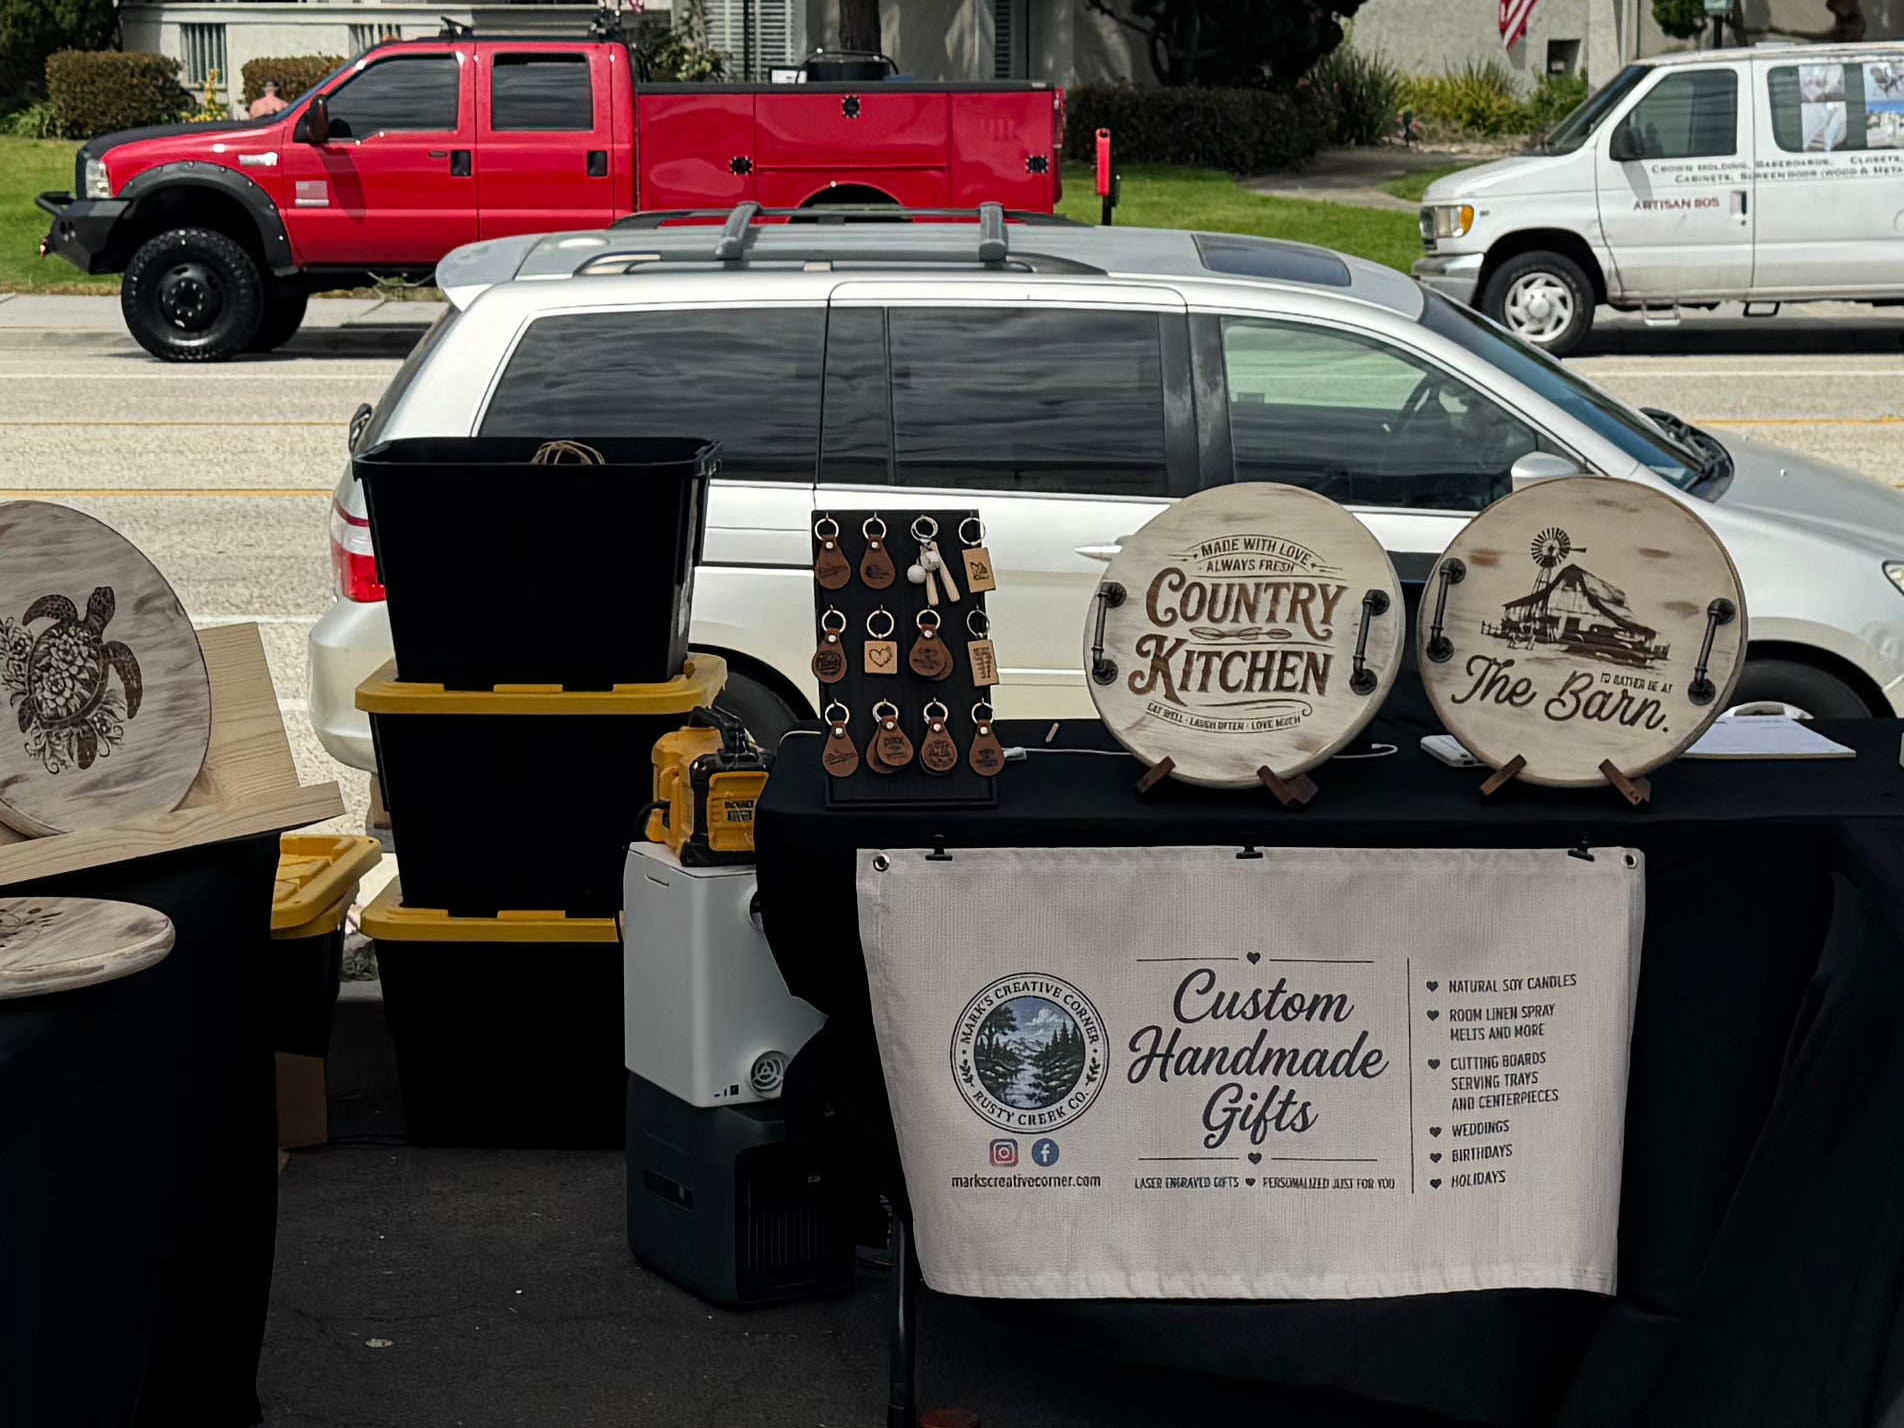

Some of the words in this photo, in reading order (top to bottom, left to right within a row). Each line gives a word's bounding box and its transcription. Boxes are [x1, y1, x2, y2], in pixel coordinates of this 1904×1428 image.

[1633, 199, 1691, 211] ARTISAN
[1201, 538, 1240, 558] MADE
[1244, 538, 1276, 552] WITH
[1279, 542, 1312, 566] LOVE
[1206, 559, 1255, 572] ALWAYS
[1259, 559, 1295, 573] FRESH
[1146, 567, 1349, 641] COUNTRY
[1127, 634, 1335, 707] KITCHEN
[1451, 655, 1537, 707] The
[1544, 670, 1669, 732] Barn.
[1449, 979, 1497, 993] NATURAL
[1503, 978, 1524, 992] SOY
[1528, 974, 1577, 990] CANDLES
[1173, 968, 1354, 1024] Custom
[960, 995, 994, 1044] MARK'S
[994, 981, 1062, 1000] CREATIVE
[1064, 994, 1100, 1045] CORNER
[1450, 1008, 1482, 1022] ROOM
[1486, 1006, 1518, 1020] LINEN
[1522, 1004, 1556, 1018] SPRAY
[1450, 1028, 1485, 1042] MELTS
[1489, 1026, 1511, 1039] AND
[1515, 1023, 1545, 1037] MORE
[1127, 1025, 1389, 1084] Handmade
[1451, 1056, 1499, 1070] CUTTING
[1503, 1052, 1546, 1067] BOARDS
[1452, 1075, 1500, 1091] SERVING
[1504, 1071, 1539, 1087] TRAYS
[973, 1090, 1015, 1123] RUSTY
[1018, 1109, 1066, 1126] CREEK
[1069, 1091, 1089, 1110] CO.
[1452, 1097, 1474, 1111] AND
[1479, 1089, 1559, 1109] CENTERPIECES
[1202, 1083, 1318, 1149] Gifts
[1452, 1120, 1510, 1137] WEDDINGS
[1452, 1144, 1513, 1163] BIRTHDAYS
[952, 1174, 1101, 1188] markscreativecorner.com
[1135, 1177, 1162, 1189] LASER
[1263, 1177, 1329, 1189] PERSONALIZED
[1332, 1178, 1353, 1189] JUST
[1356, 1178, 1374, 1189] FOR
[1377, 1178, 1395, 1189] YOU
[1451, 1170, 1506, 1188] HOLIDAYS
